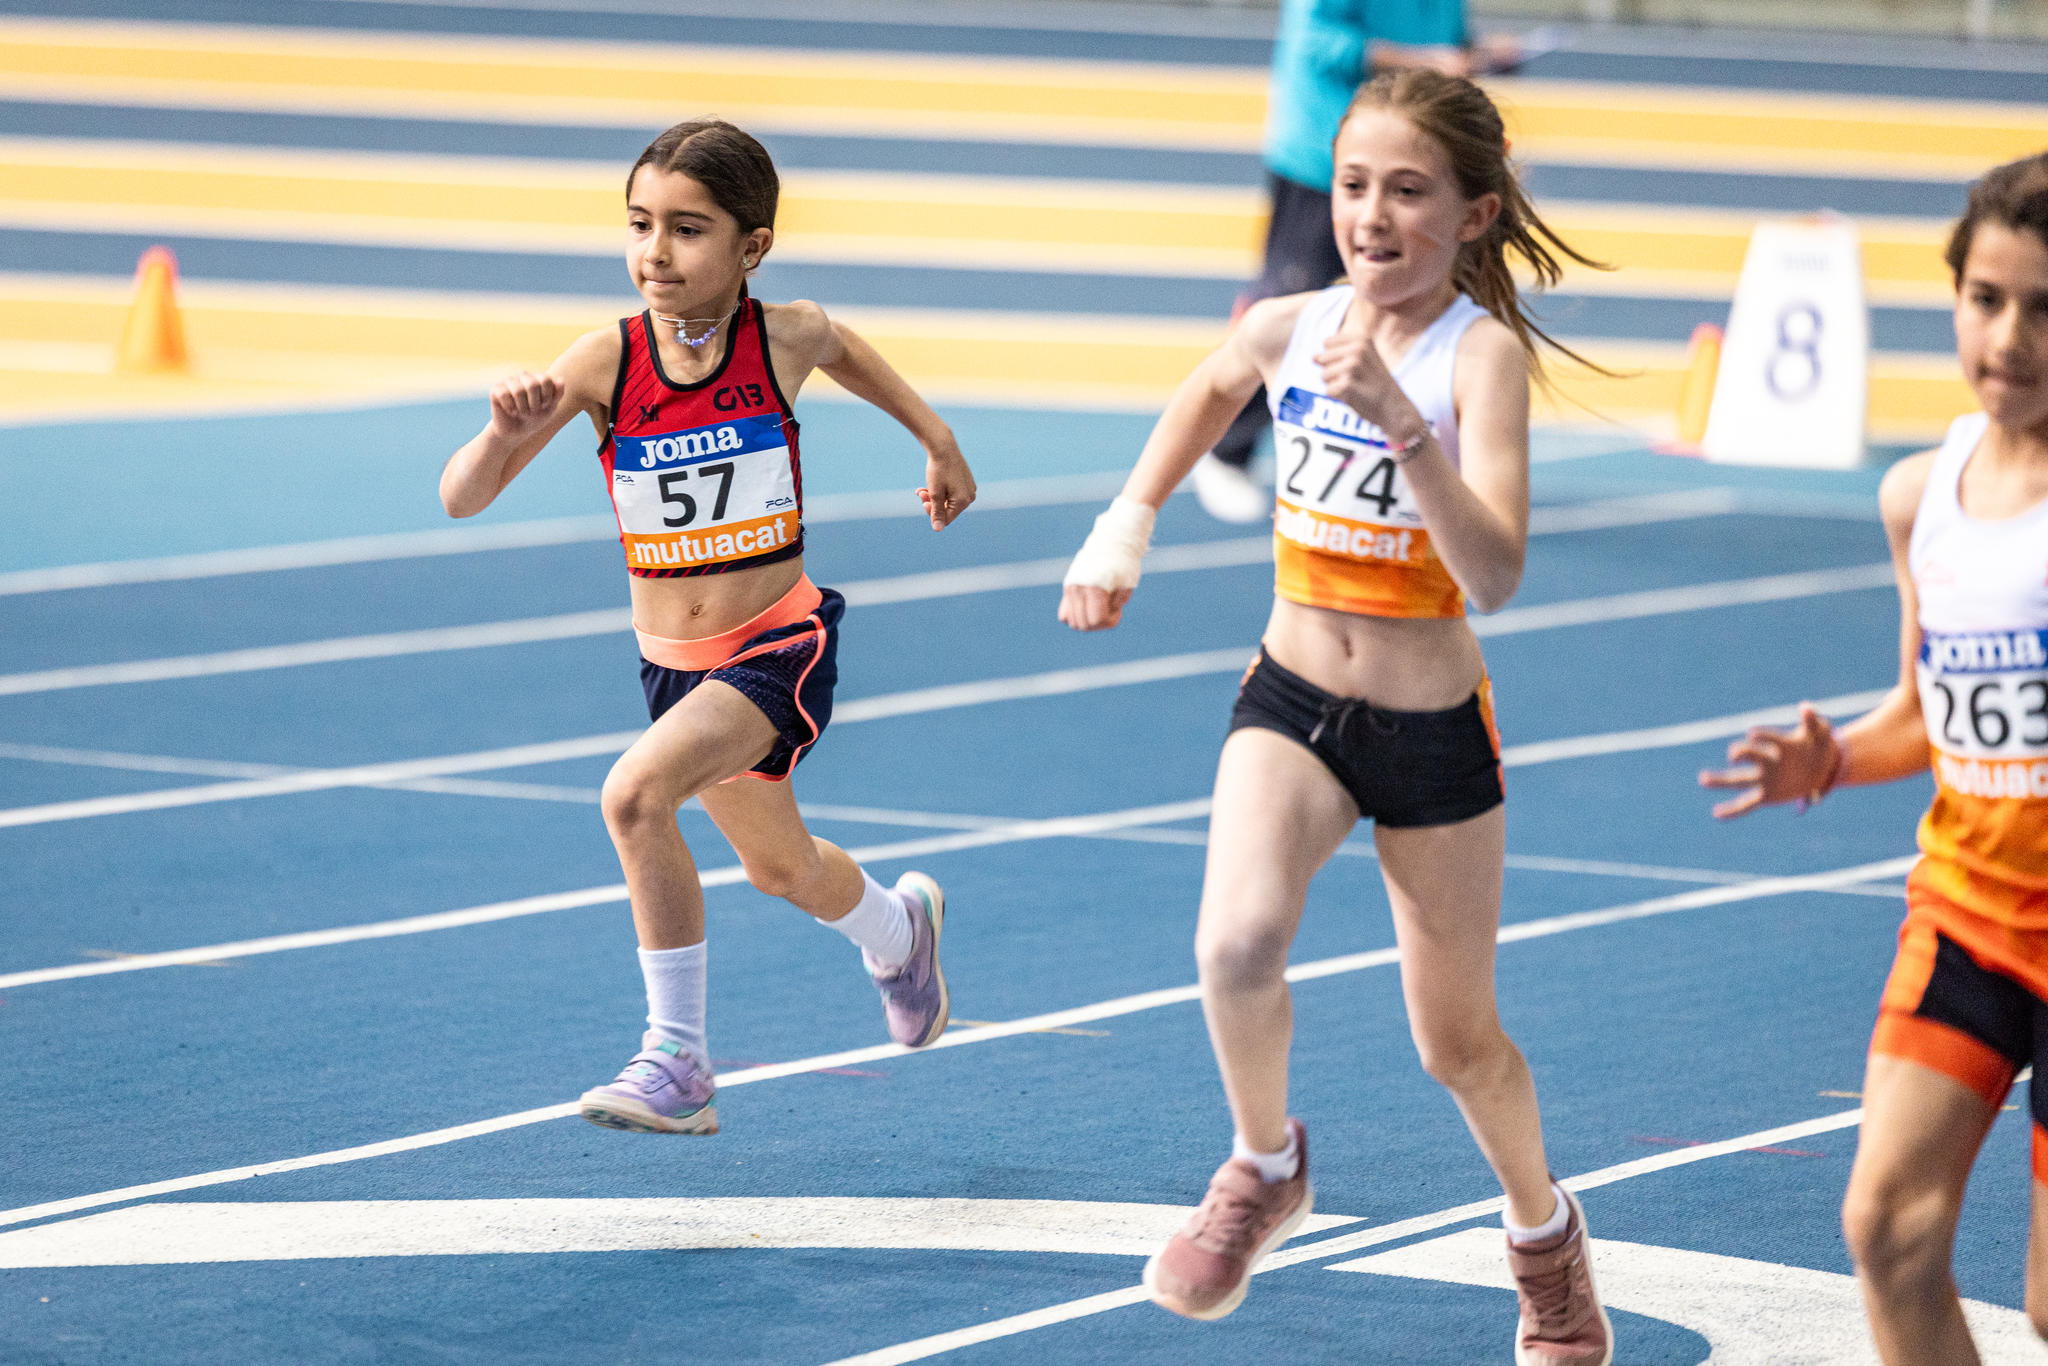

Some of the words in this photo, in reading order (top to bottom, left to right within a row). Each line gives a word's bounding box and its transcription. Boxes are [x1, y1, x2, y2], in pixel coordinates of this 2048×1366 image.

[1765, 300, 1822, 402] 8
[658, 462, 735, 528] 57
[765, 496, 792, 508] FCA
[1287, 436, 1398, 516] 274
[634, 518, 787, 564] mutuacat
[1934, 680, 2048, 747] 263
